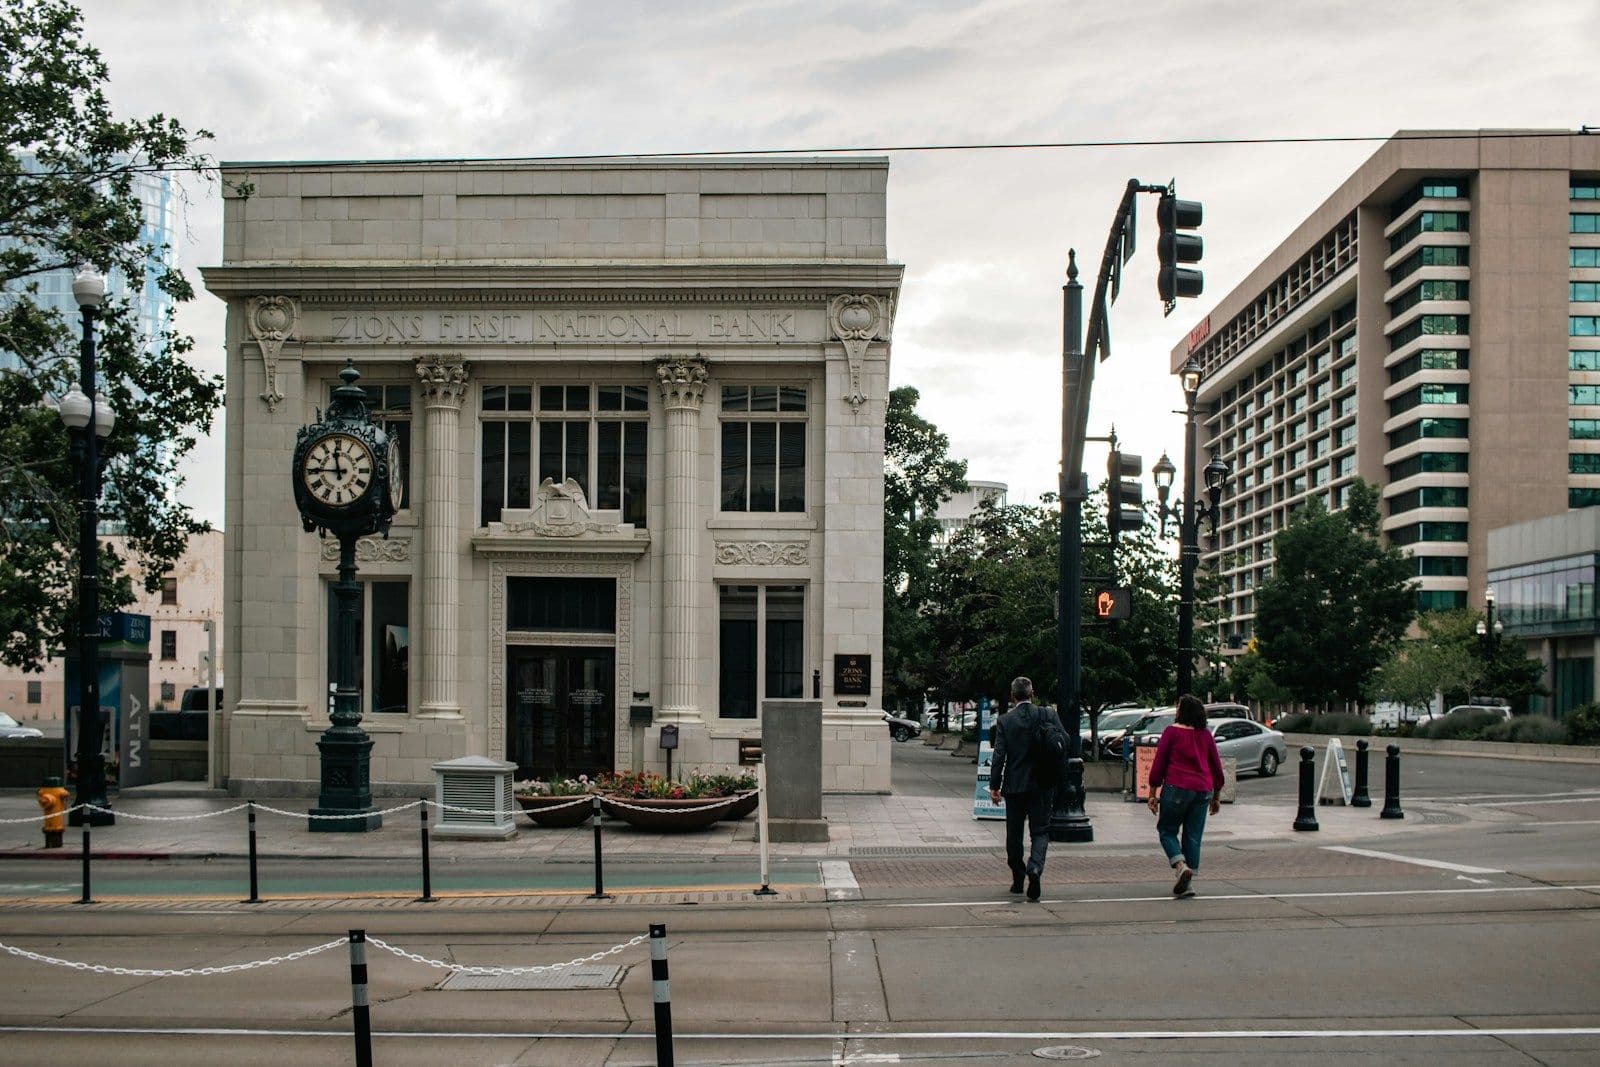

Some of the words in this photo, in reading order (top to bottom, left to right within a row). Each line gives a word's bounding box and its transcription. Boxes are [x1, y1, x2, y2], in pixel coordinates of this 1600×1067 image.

[332, 315, 423, 339] ZIONS
[440, 315, 521, 338] FIRST
[539, 314, 694, 338] NATIONAL
[709, 313, 795, 337] BANK
[129, 694, 141, 767] ATM
